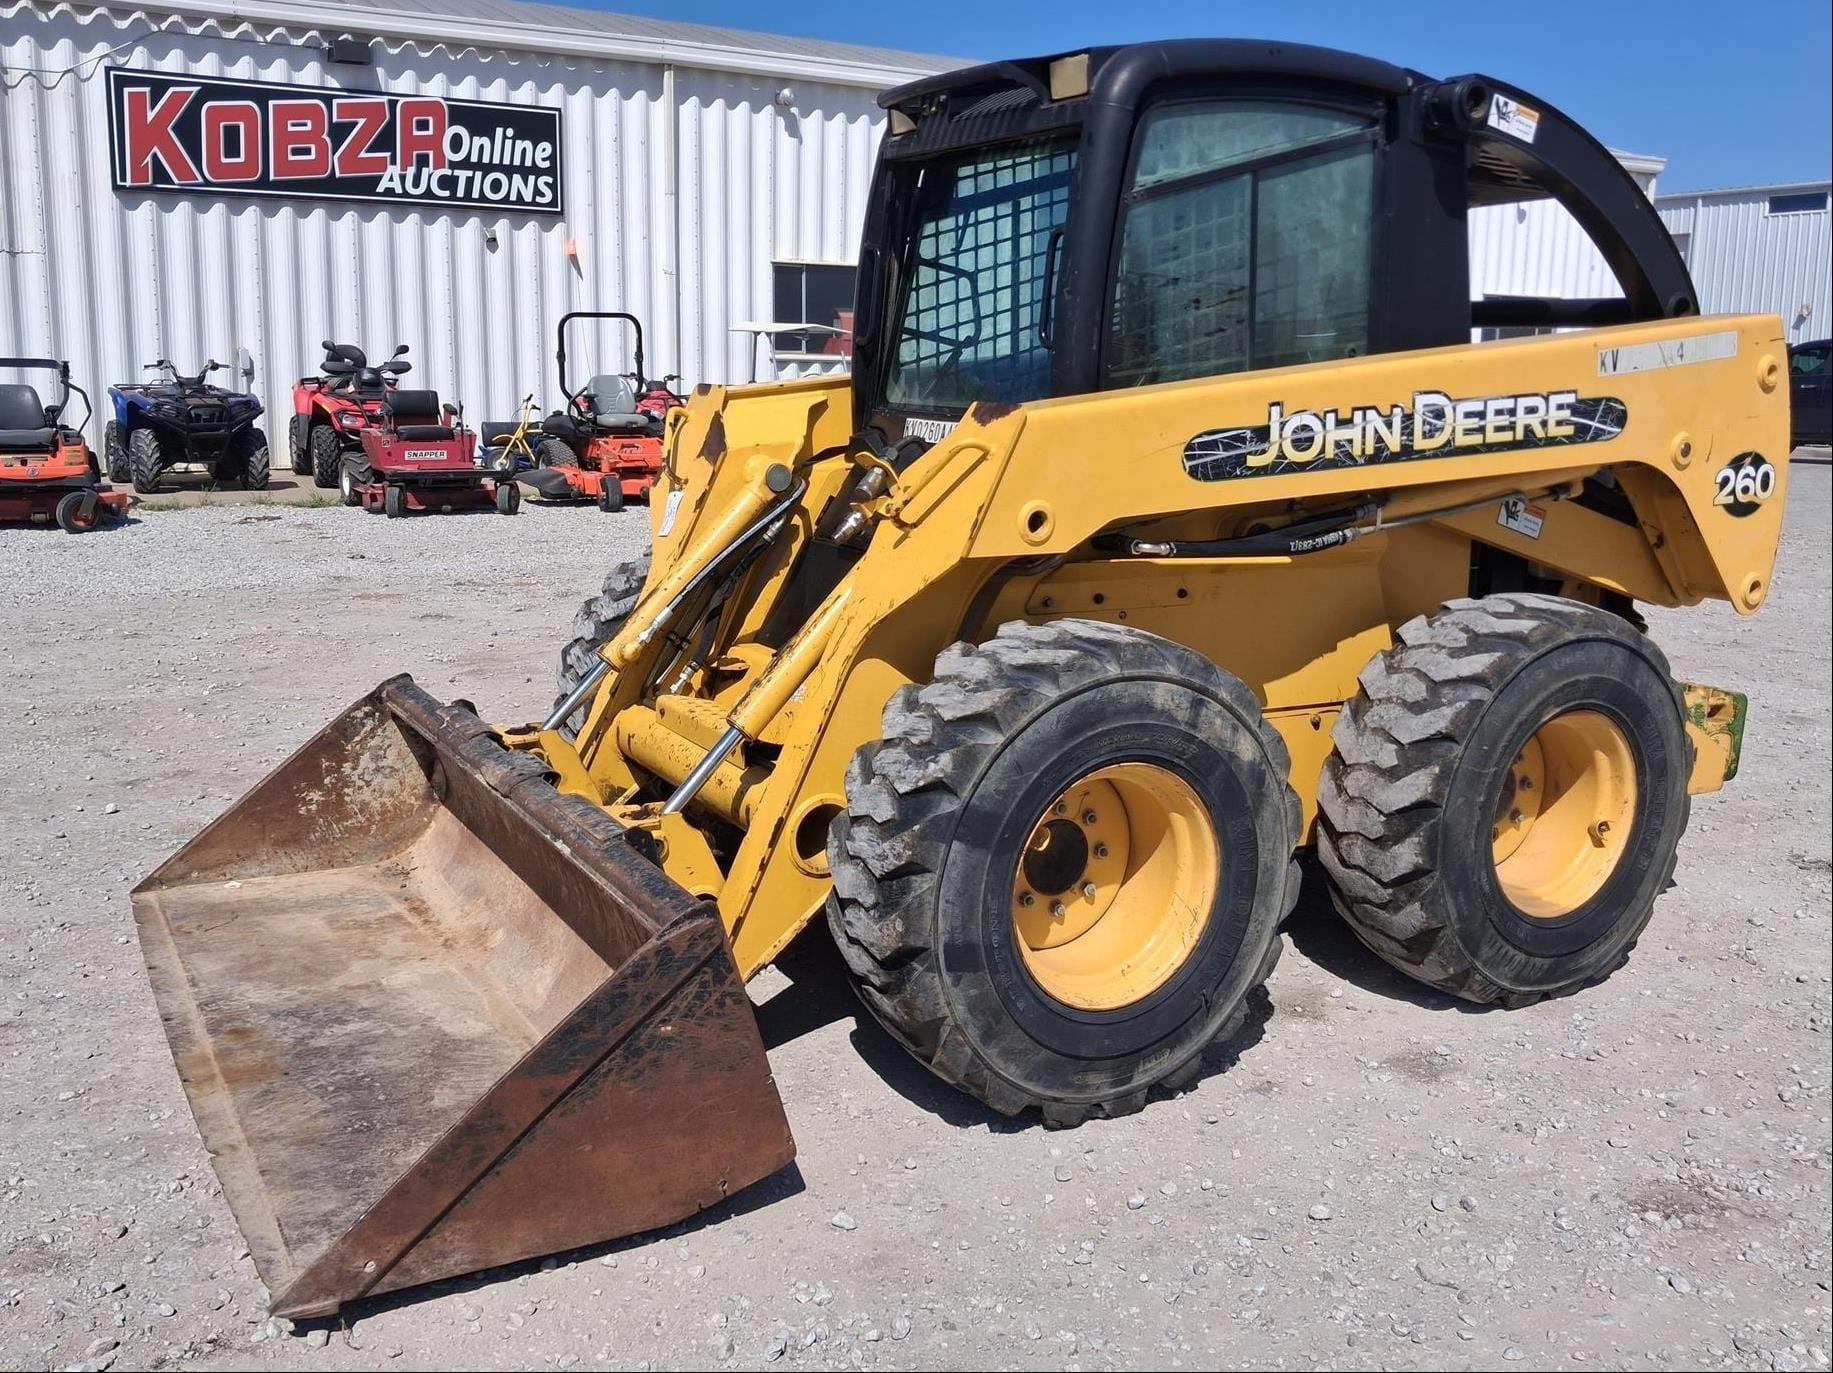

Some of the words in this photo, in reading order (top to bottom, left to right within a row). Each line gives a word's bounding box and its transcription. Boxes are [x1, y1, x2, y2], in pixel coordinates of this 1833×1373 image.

[123, 86, 449, 187] KOBZA
[442, 126, 553, 169] Online
[376, 165, 555, 203] AUCTIONS
[1246, 401, 1402, 468] JOHN
[1413, 390, 1578, 451] DEERE
[1713, 464, 1776, 506] 260
